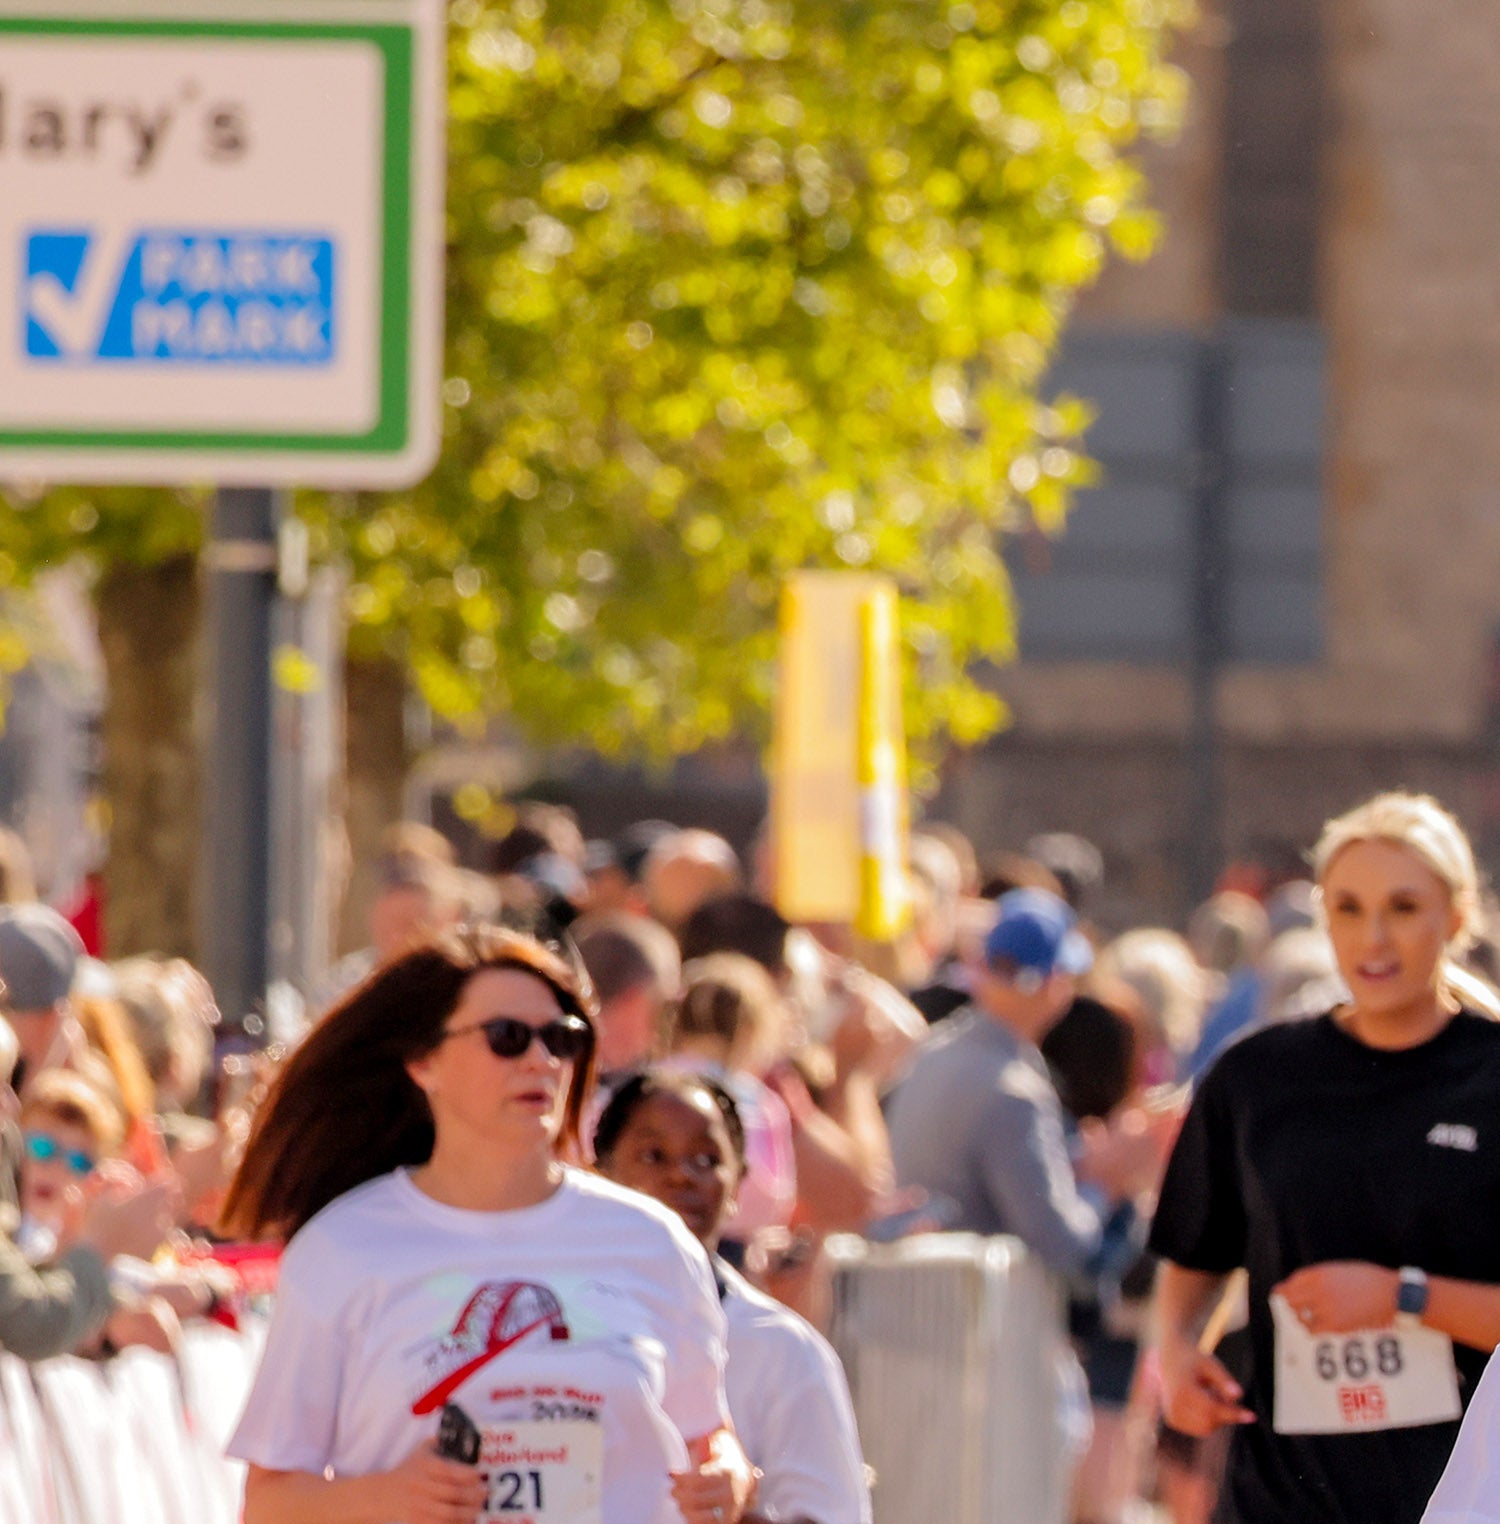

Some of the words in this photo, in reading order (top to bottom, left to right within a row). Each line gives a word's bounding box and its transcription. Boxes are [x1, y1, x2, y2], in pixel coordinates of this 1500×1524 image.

[0, 80, 250, 174] ary's
[140, 238, 320, 296] PARK
[131, 299, 326, 354] MARK
[1316, 1337, 1403, 1381] 668
